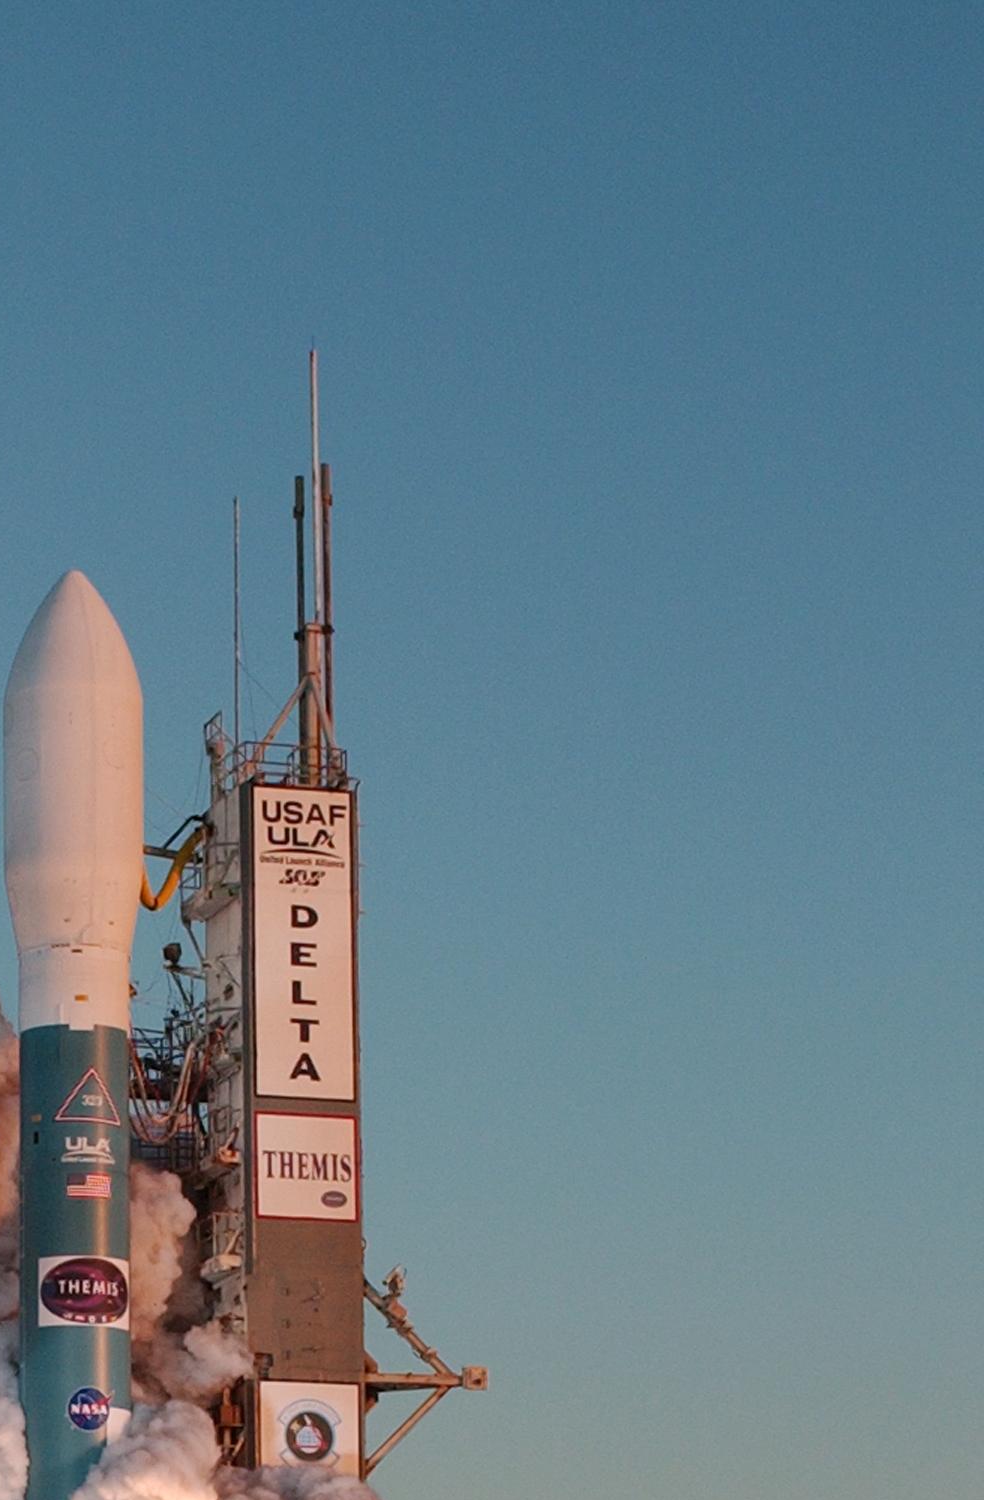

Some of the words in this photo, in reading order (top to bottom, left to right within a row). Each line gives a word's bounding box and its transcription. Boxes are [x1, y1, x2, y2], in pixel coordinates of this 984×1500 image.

[262, 800, 347, 826] USAF
[267, 826, 336, 849] ULA
[289, 904, 321, 1081] DELTA
[65, 1136, 111, 1152] ULA
[262, 1150, 352, 1182] THEMIS
[58, 1279, 118, 1297] THEMIS
[70, 1403, 108, 1416] NASA
